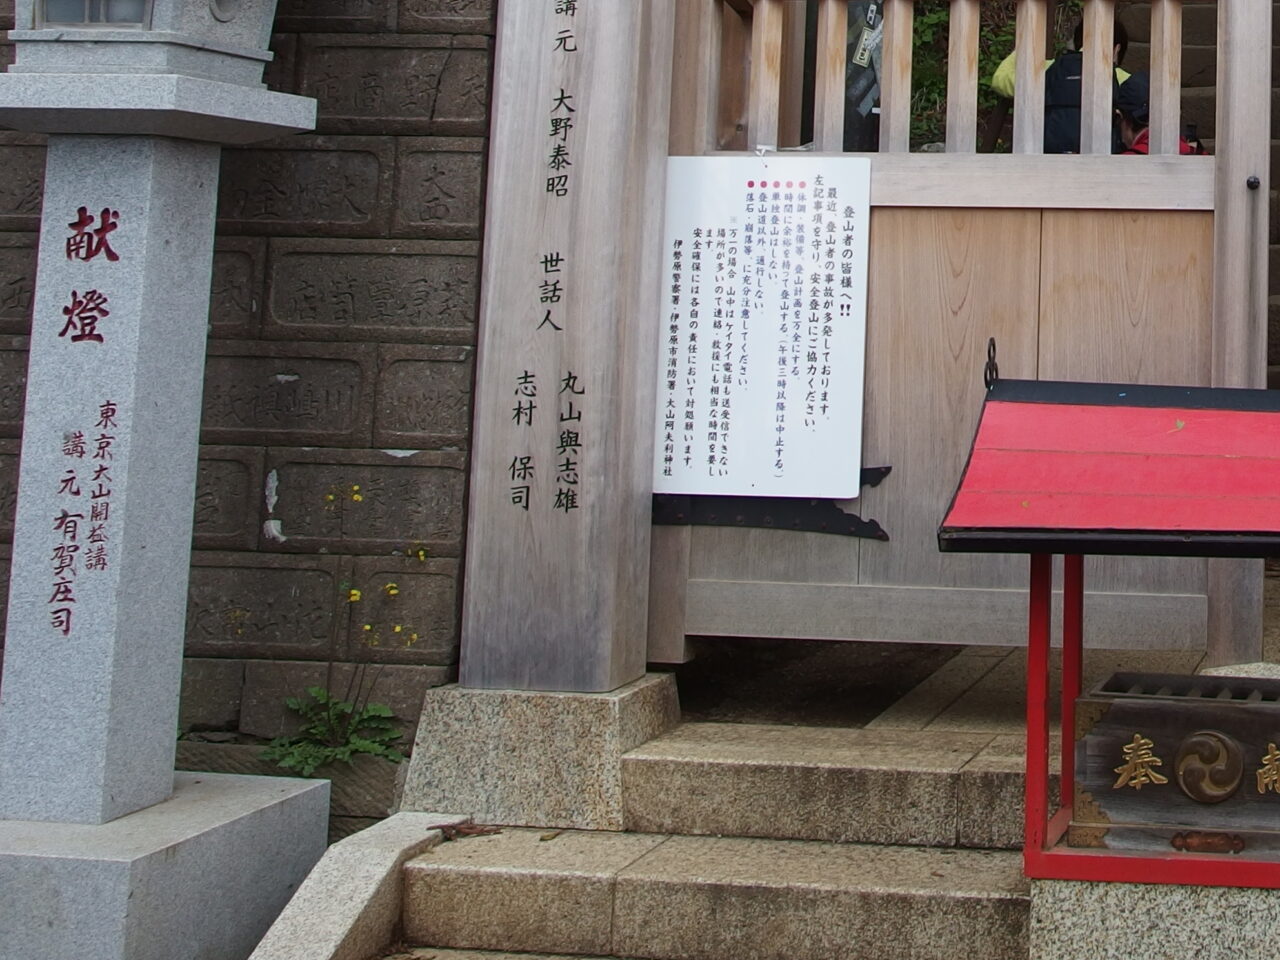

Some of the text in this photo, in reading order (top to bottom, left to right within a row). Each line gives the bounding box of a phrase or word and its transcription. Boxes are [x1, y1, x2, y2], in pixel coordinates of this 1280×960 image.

[545, 89, 576, 198] 大野泰昭
[537, 252, 564, 332] 世話人
[1112, 732, 1169, 791] 奉
